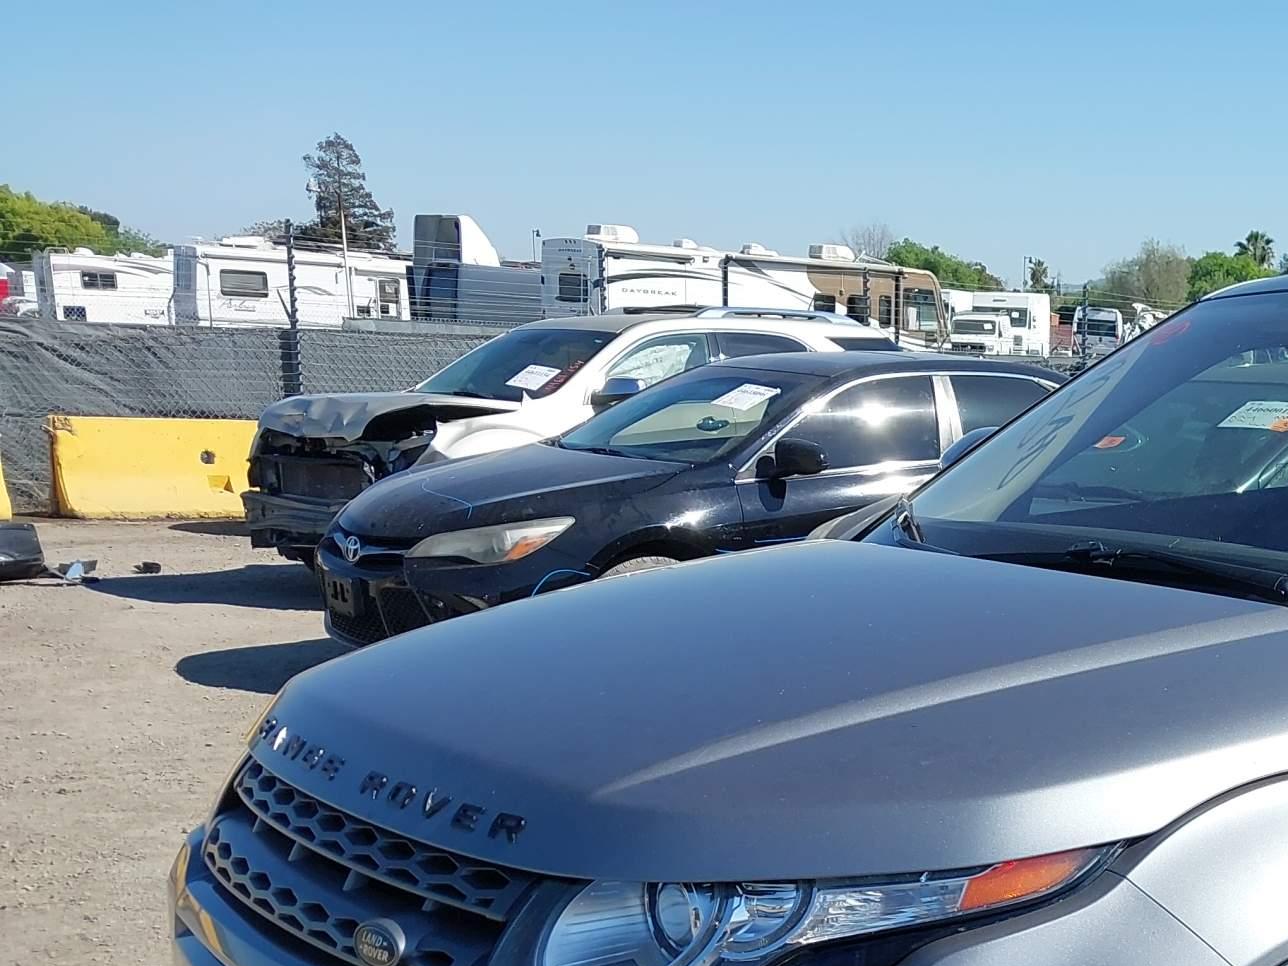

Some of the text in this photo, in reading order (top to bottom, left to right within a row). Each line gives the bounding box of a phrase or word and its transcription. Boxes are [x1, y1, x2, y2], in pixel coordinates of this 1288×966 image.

[621, 287, 678, 297] DAYBREAK
[258, 717, 528, 844] RANGE ROVER
